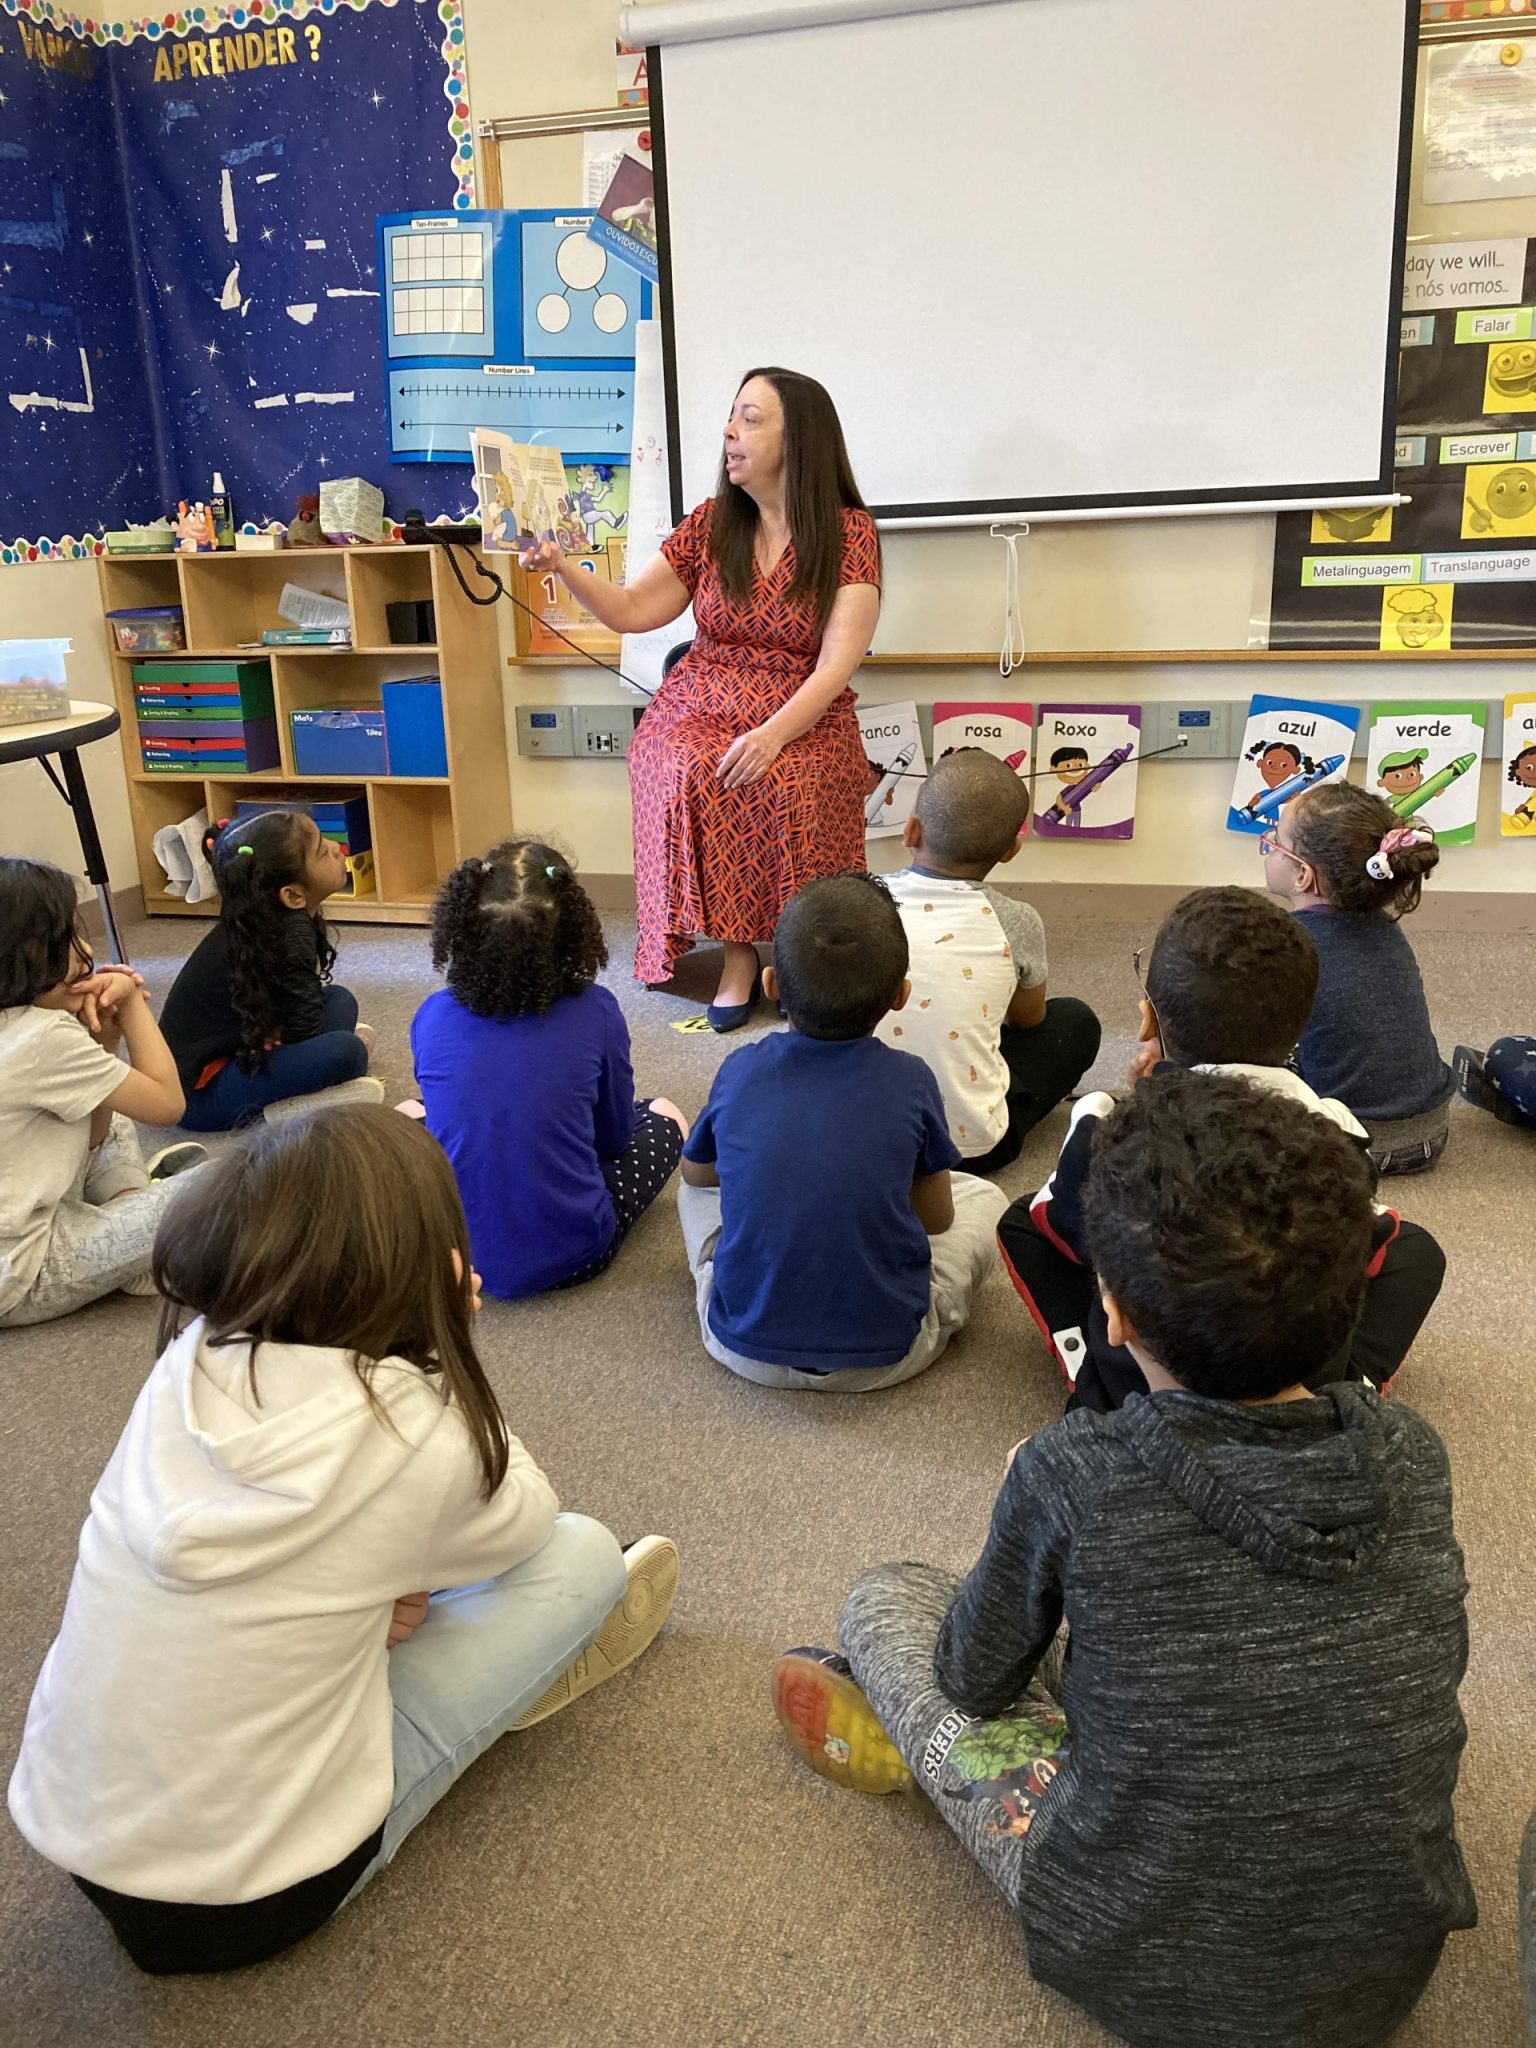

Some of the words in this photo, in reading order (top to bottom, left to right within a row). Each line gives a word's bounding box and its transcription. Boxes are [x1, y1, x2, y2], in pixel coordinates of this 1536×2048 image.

[153, 28, 298, 82] APRENDER
[304, 24, 322, 62] ?
[605, 226, 639, 255] OUVIDOS
[1440, 255, 1463, 270] we
[1416, 279, 1444, 298] nós
[1474, 320, 1511, 333] Falar
[1449, 442, 1511, 456] Escrever
[1313, 563, 1411, 579] Metalinguagem
[1431, 556, 1531, 573] Translanguage
[542, 575, 556, 602] 1
[293, 714, 313, 722] Mats
[1522, 718, 1536, 730] a
[965, 725, 1002, 738] rosa
[1054, 720, 1097, 737] Roxo
[1278, 720, 1317, 738] azul
[1395, 720, 1452, 737] verde
